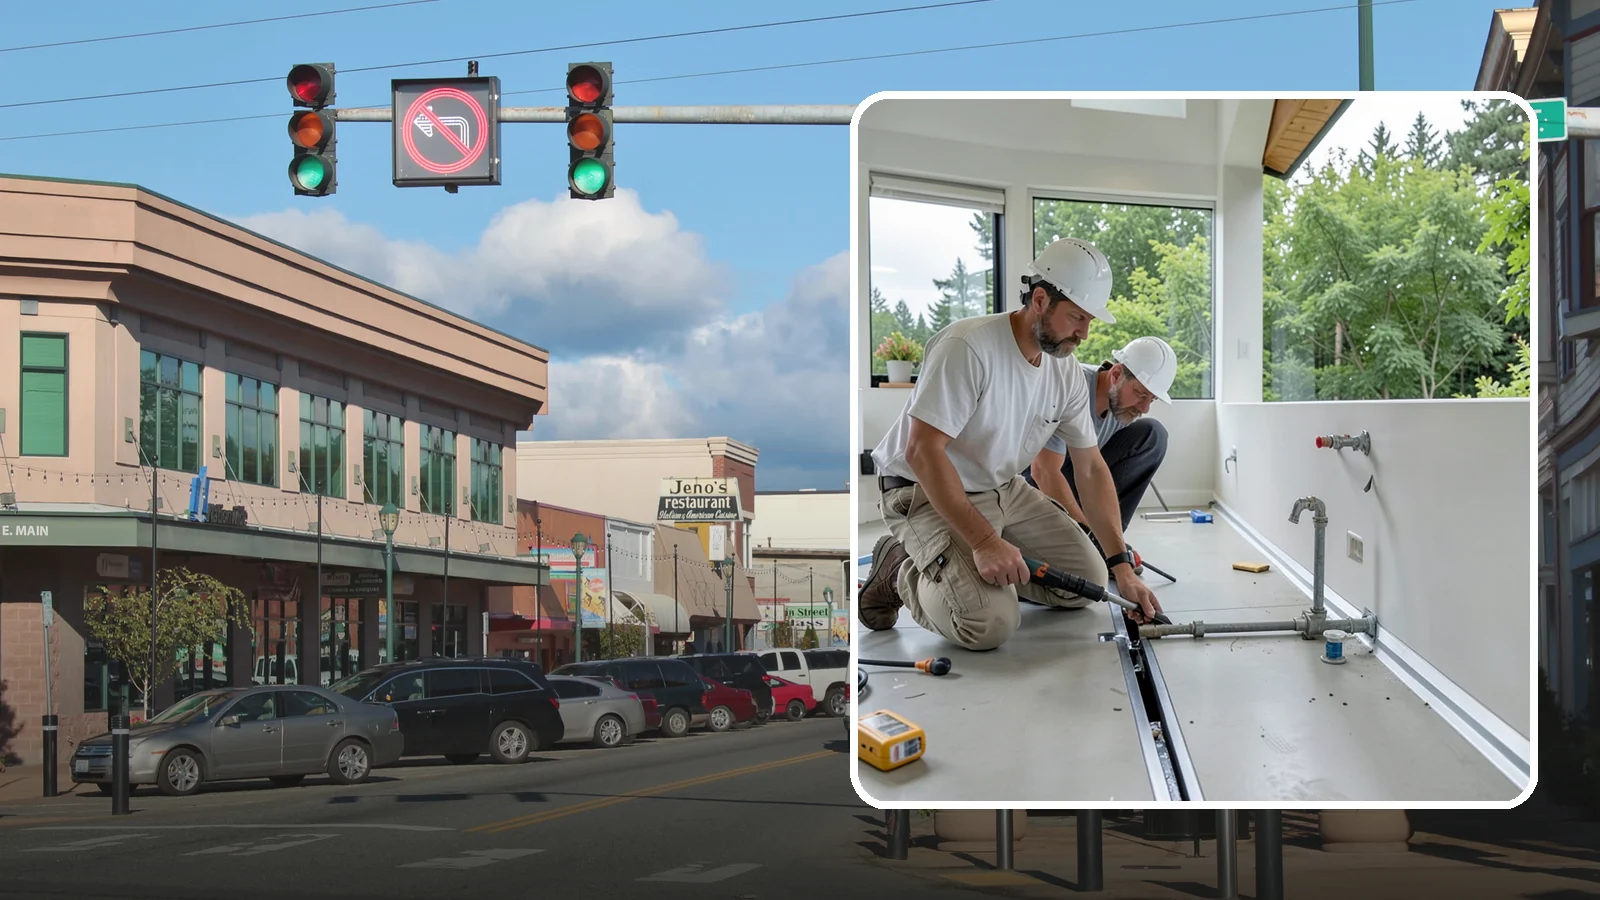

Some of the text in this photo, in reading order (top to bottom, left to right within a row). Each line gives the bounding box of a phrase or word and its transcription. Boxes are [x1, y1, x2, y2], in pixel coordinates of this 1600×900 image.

[670, 480, 727, 494] Jeno's
[665, 496, 730, 509] restaurant
[659, 510, 681, 519] Italian
[686, 510, 714, 519] American
[715, 509, 737, 519] Cuisine
[3, 525, 49, 536] E. MAIN
[797, 608, 828, 616] Street
